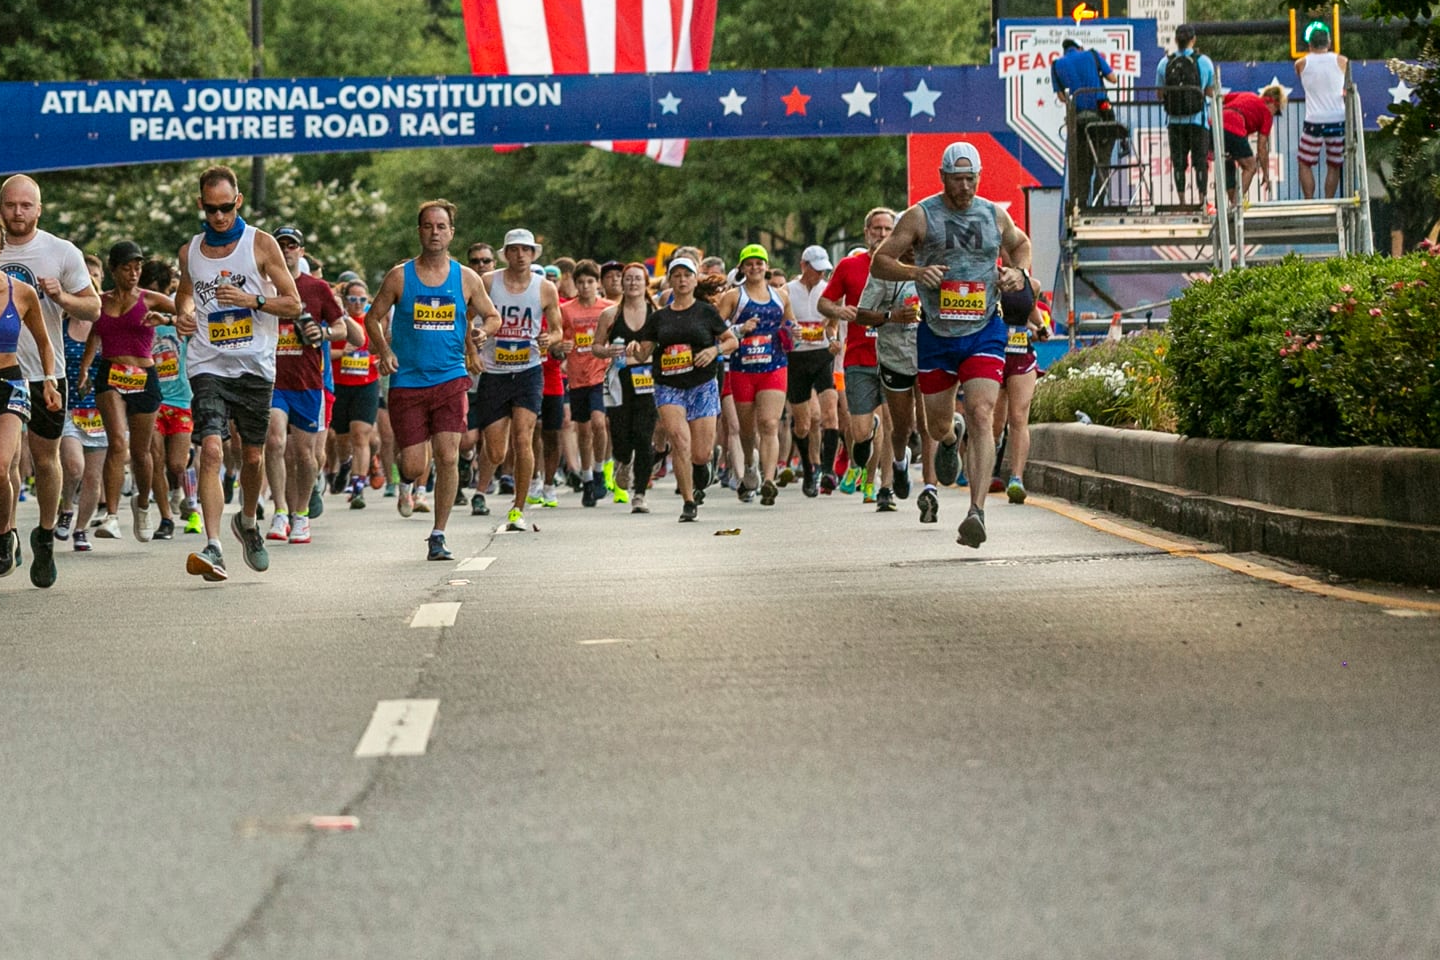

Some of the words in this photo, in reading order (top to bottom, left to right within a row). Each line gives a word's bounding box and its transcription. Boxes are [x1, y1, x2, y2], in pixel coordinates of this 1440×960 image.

[1138, 0, 1154, 8] LEFT
[1158, 0, 1176, 8] TURN
[1003, 51, 1136, 73] PEACEE
[41, 89, 175, 114] ATLANTA
[182, 82, 561, 113] JOURNAL-CONSTITUTION
[130, 115, 295, 141] PEACHTREE
[305, 113, 389, 138] ROAD
[400, 112, 475, 136] RACE
[944, 220, 983, 250] M
[943, 297, 984, 308] D20242
[416, 309, 453, 319] D21634
[211, 325, 250, 338] D21418
